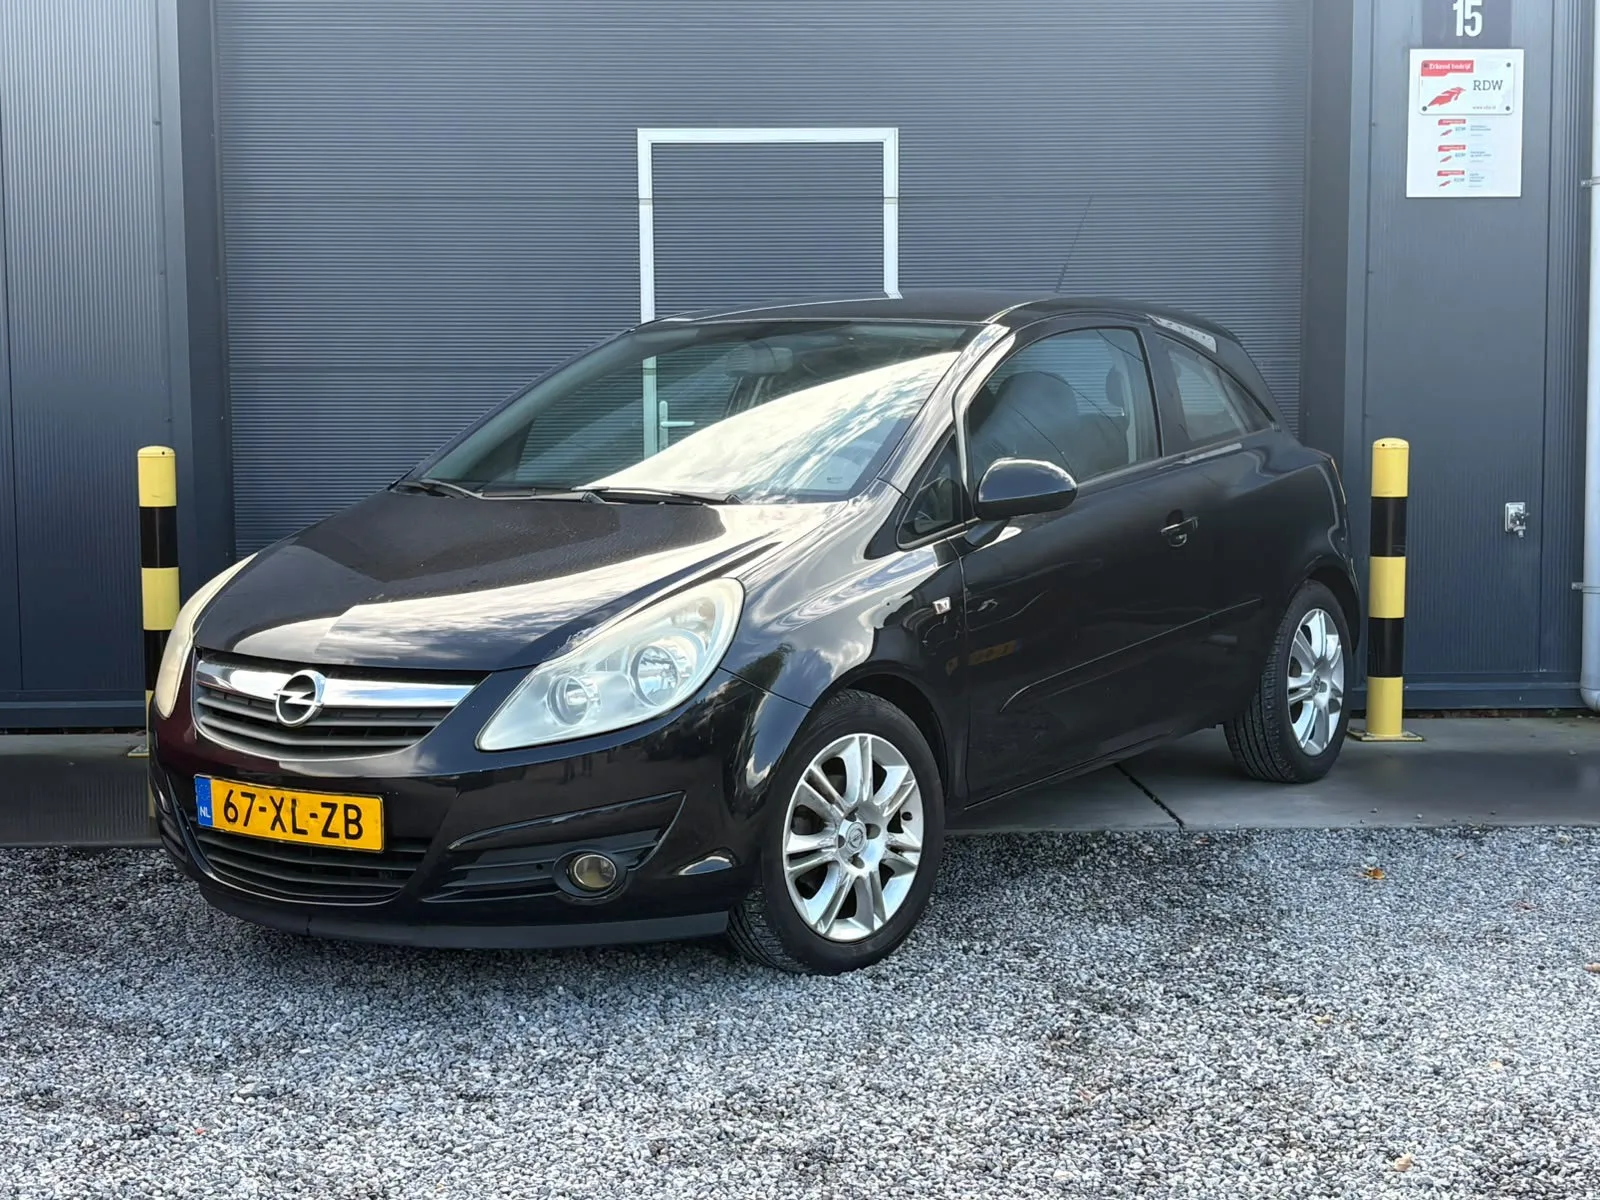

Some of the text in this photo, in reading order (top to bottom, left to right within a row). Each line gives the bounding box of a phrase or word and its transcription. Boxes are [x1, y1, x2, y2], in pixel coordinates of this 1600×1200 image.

[1453, 0, 1482, 37] 15
[1473, 80, 1503, 91] RDW
[200, 806, 211, 818] NL
[223, 789, 363, 840] 67-XL-ZB
